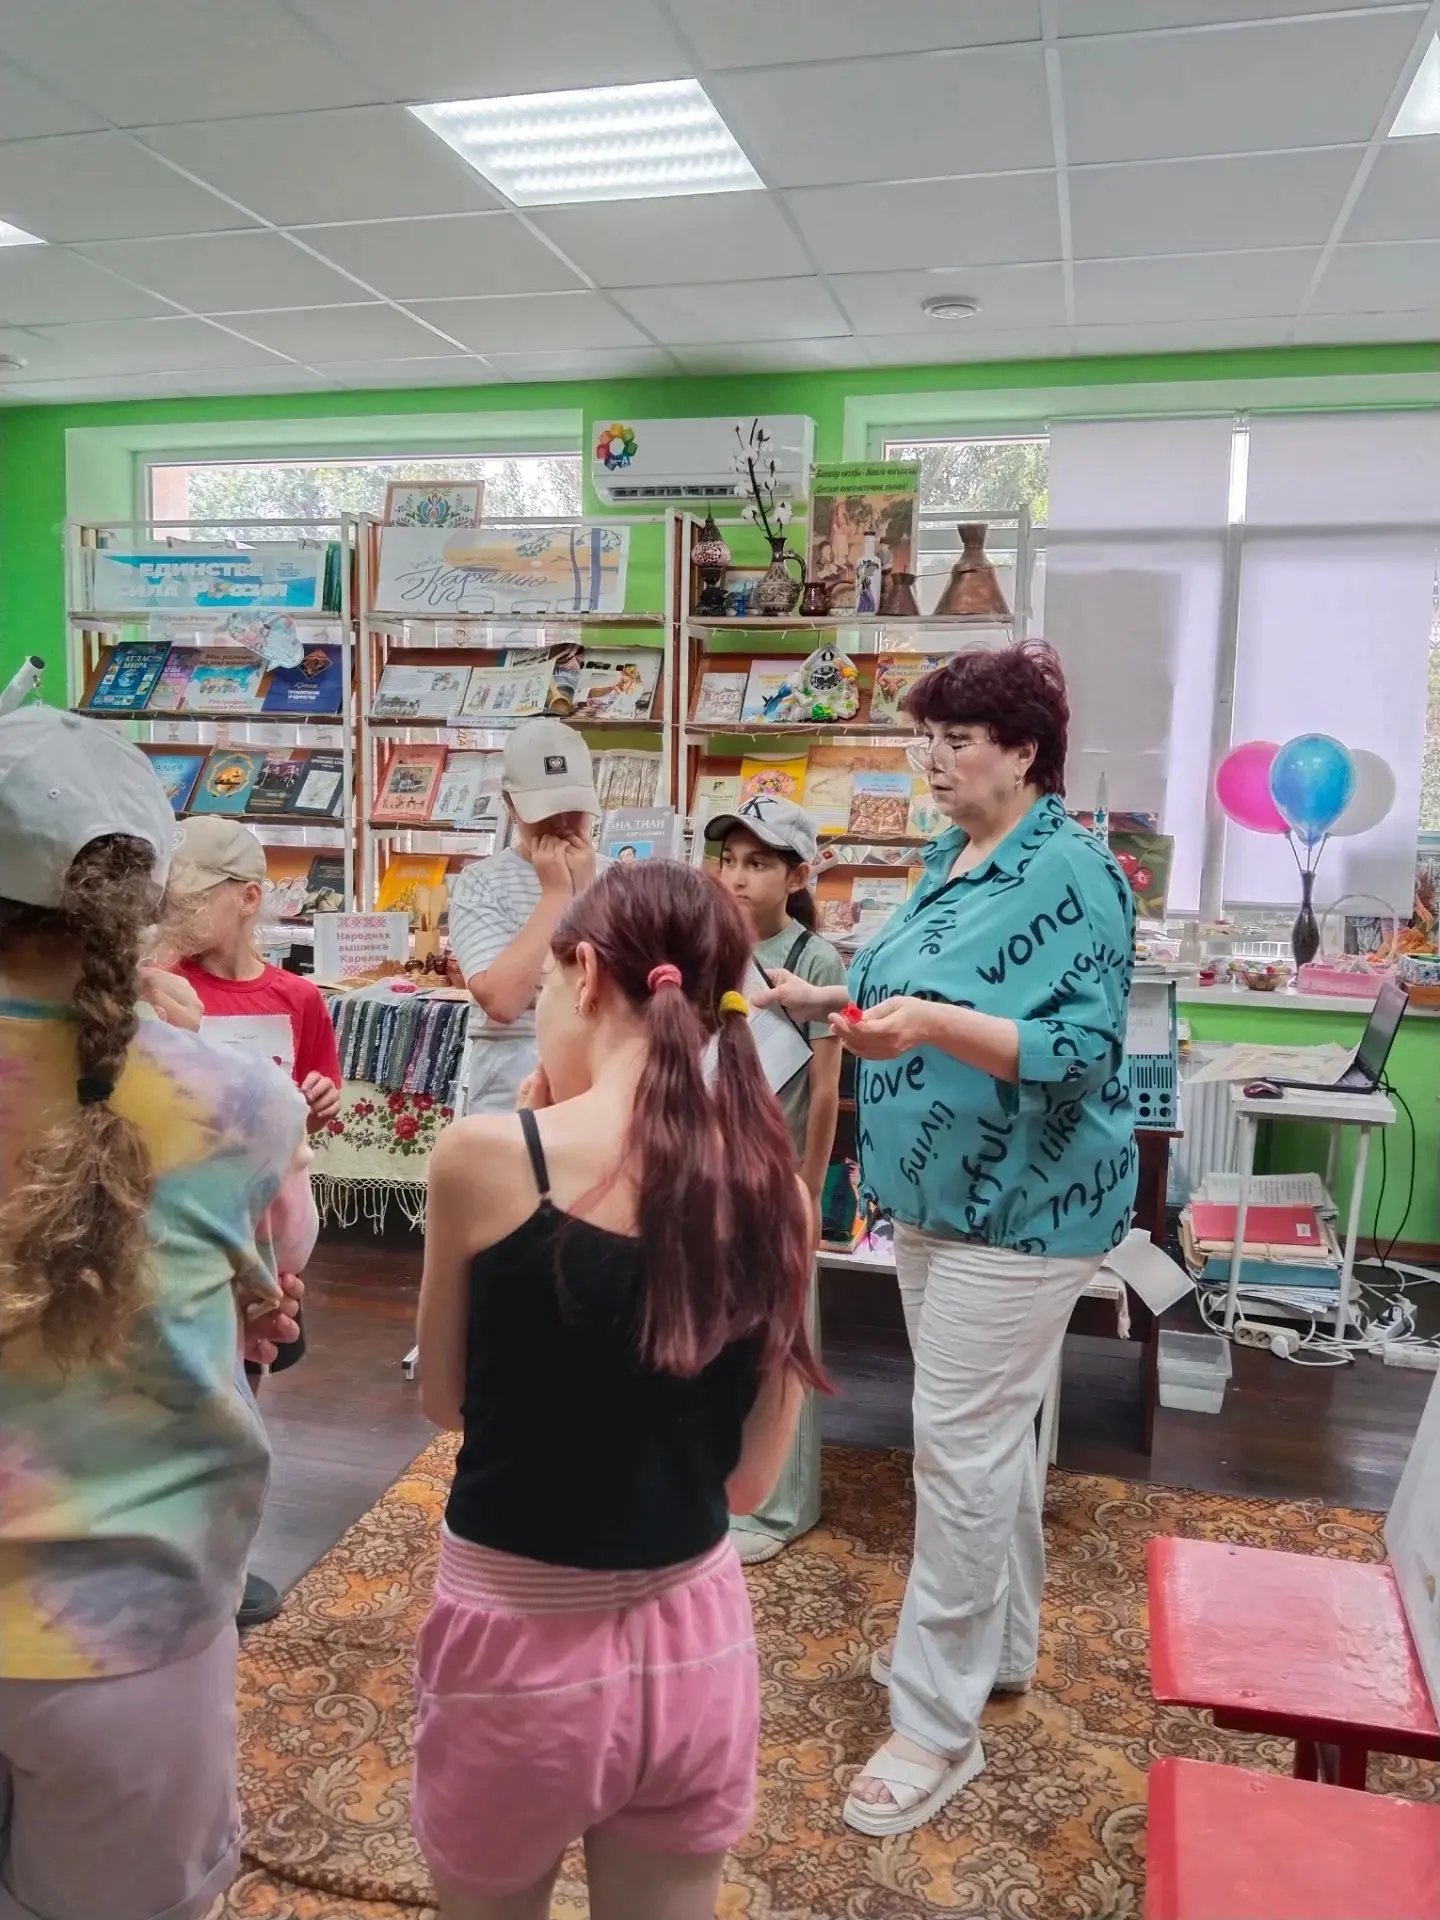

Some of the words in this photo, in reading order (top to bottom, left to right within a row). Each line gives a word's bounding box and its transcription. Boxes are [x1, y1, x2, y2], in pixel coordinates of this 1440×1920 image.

[139, 563, 264, 577] ЕДИНСТВЕ
[121, 583, 178, 598] СИЛА
[336, 932, 392, 942] Народная
[975, 884, 1084, 985] wond
[339, 943, 389, 952] вышивка
[863, 1055, 926, 1105] love
[900, 1100, 955, 1186] living
